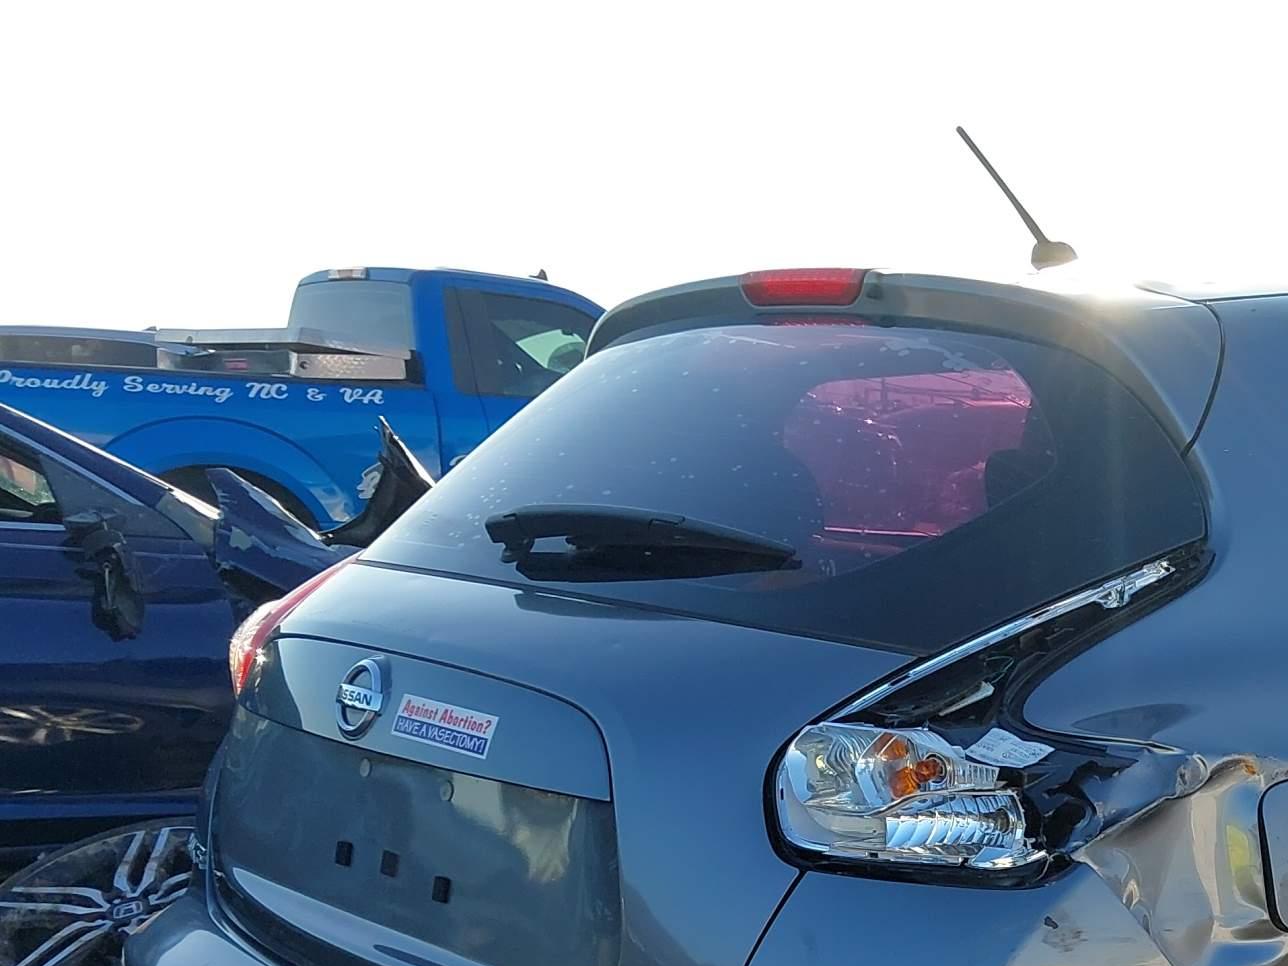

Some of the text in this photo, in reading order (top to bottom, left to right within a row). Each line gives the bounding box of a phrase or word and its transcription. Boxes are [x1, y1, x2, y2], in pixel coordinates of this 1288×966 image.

[0, 369, 384, 404] Proudly Serving NC & VA
[338, 687, 372, 706] SSAN
[401, 699, 492, 735] Against Abortion?
[397, 717, 485, 754] HAVE A VASECTOMY!
